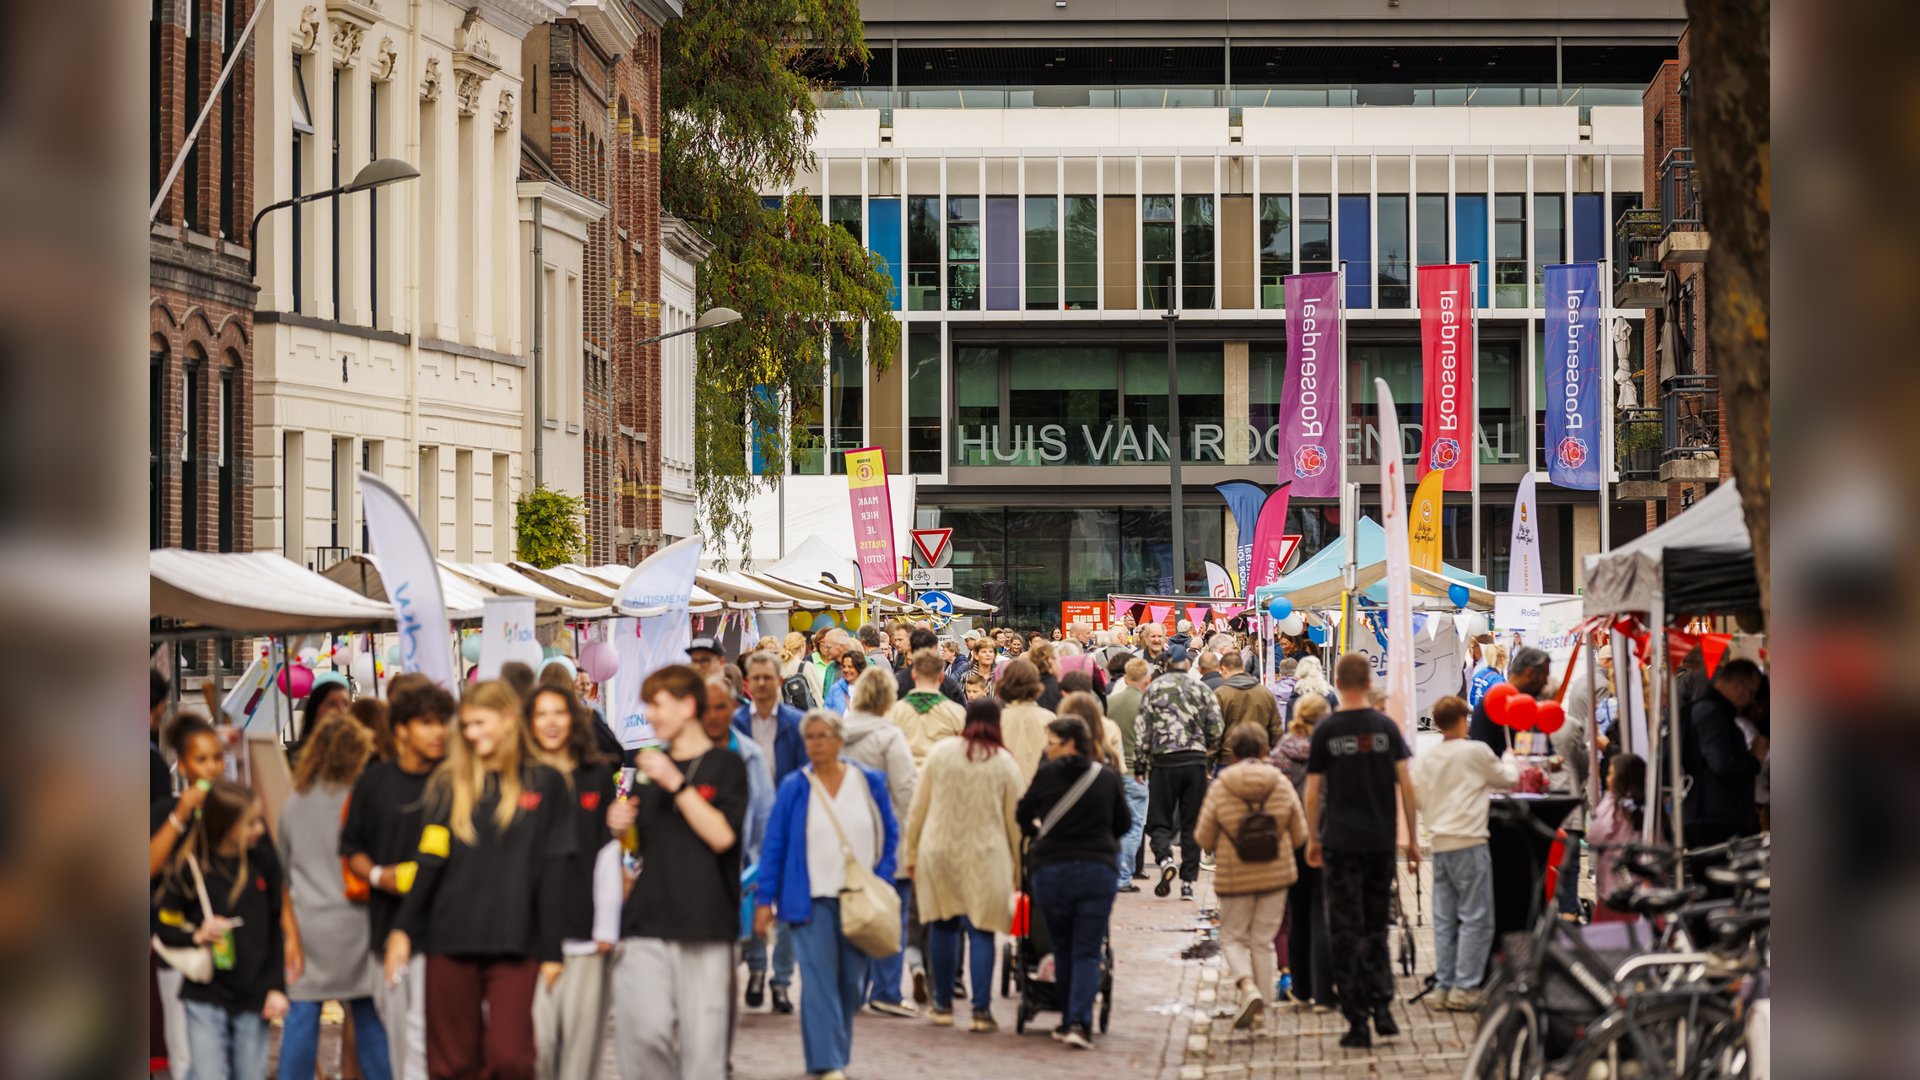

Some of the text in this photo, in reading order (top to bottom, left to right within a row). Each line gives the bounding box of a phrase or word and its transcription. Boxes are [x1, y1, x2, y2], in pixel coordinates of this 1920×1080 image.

[957, 423, 1520, 461] HUIS VAN ROENDL
